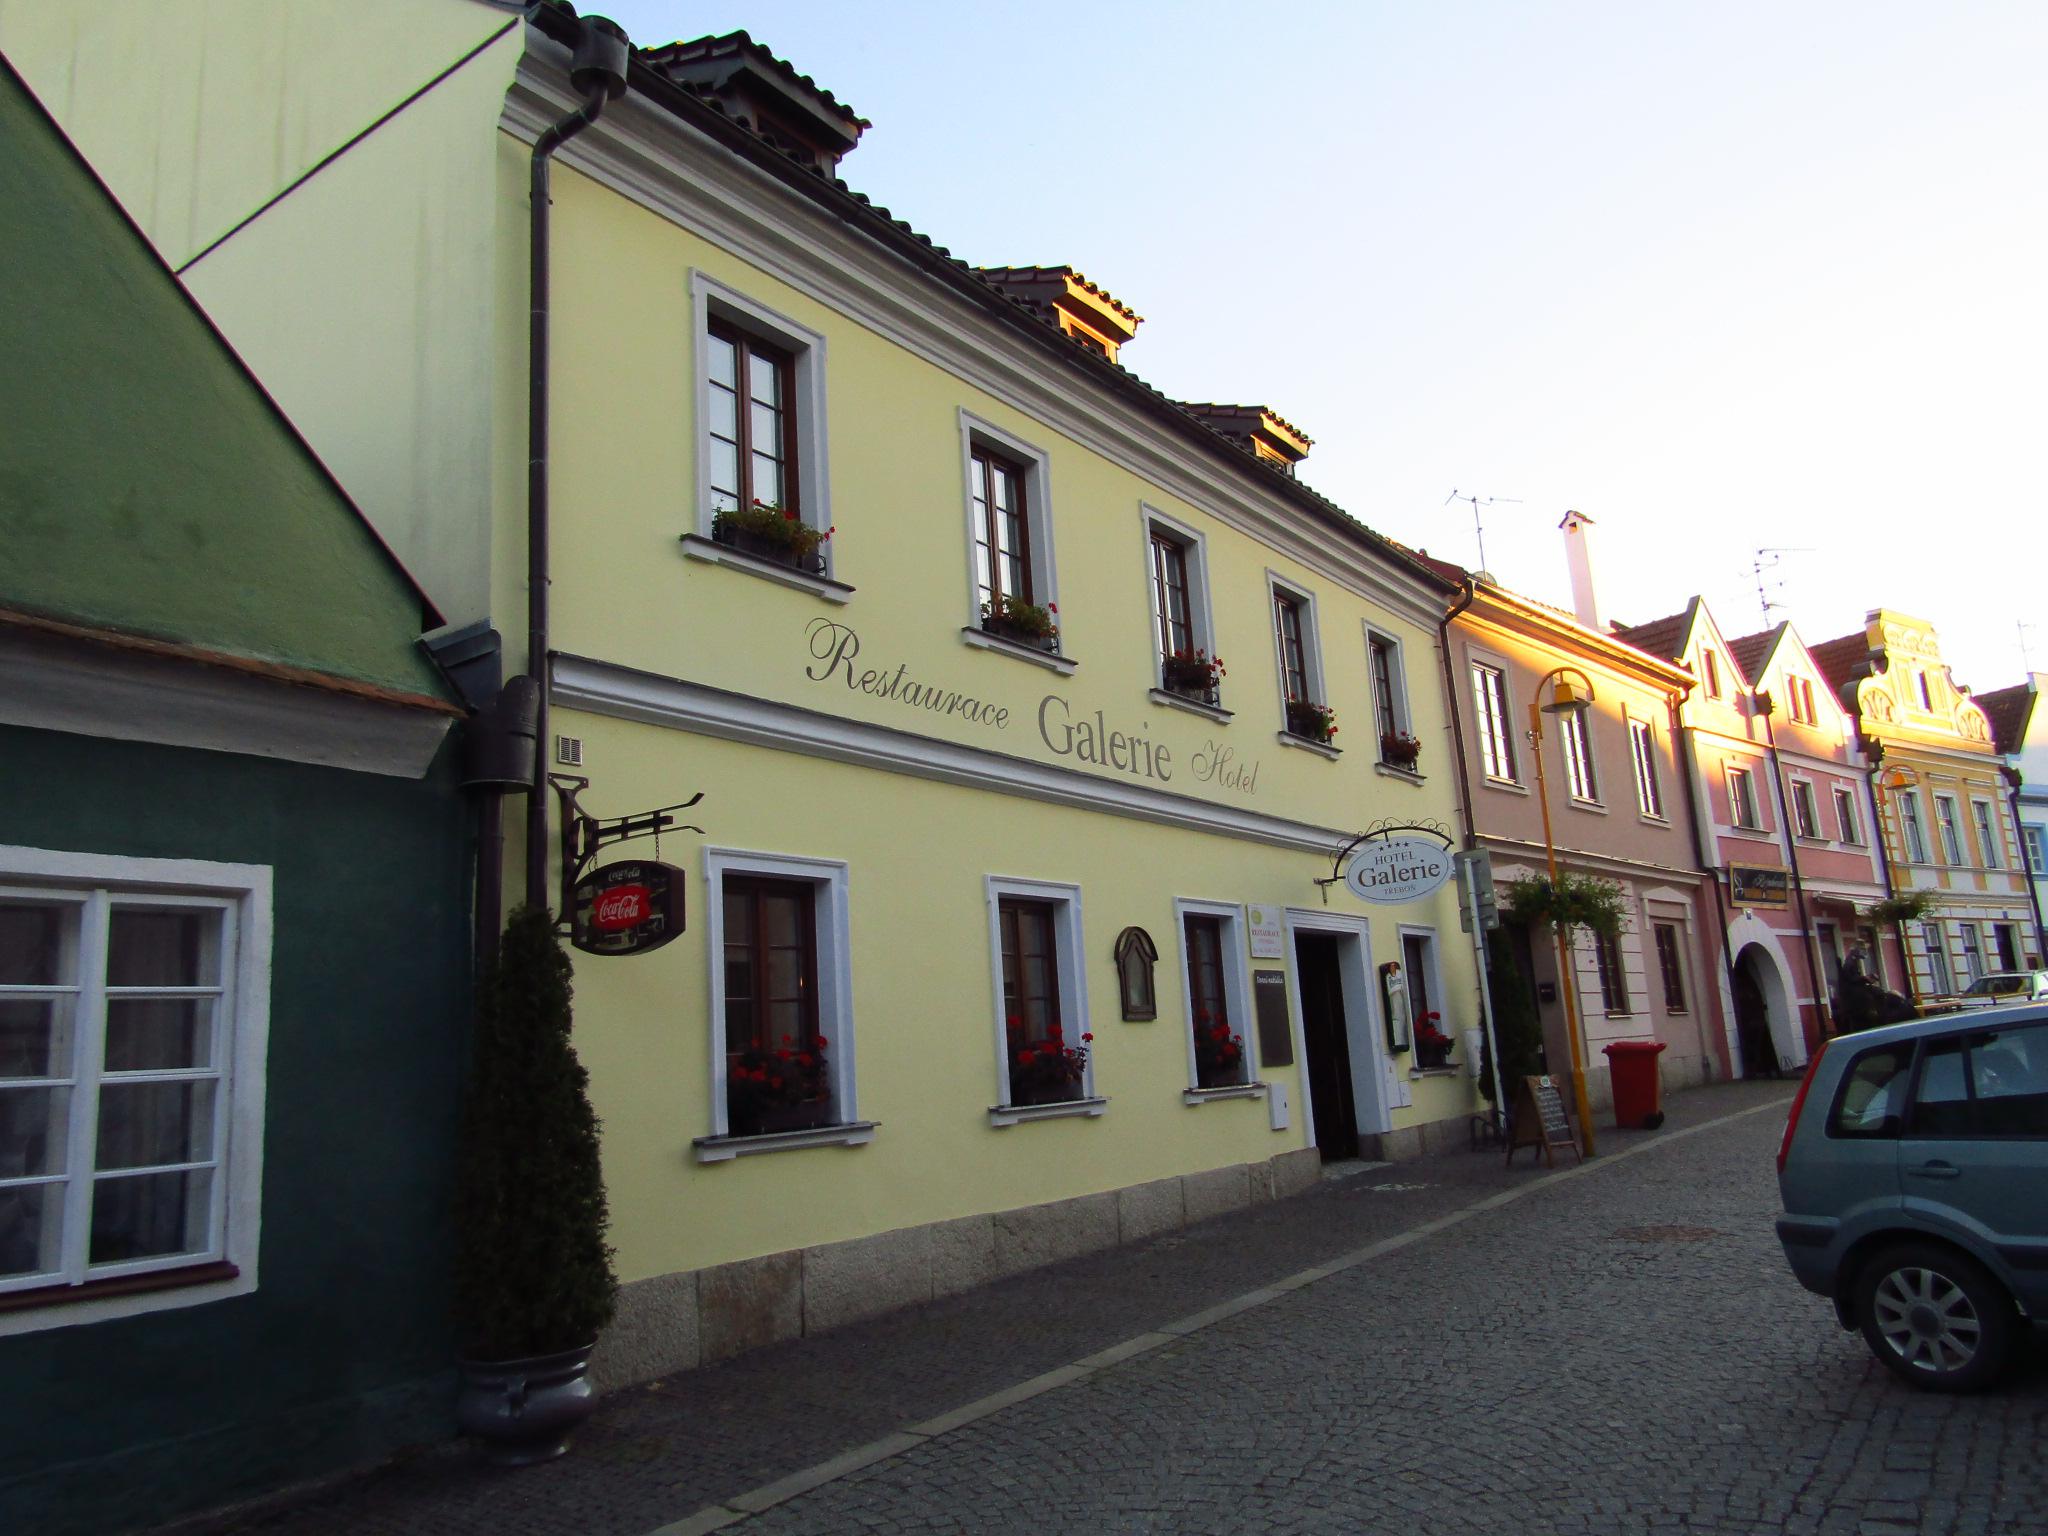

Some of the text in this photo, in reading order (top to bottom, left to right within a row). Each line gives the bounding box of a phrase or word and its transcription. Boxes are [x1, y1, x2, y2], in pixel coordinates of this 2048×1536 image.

[804, 617, 1259, 796] Restaurace Galerie Hotel
[1375, 851, 1416, 866] HOTEL
[1358, 859, 1441, 888] Galerie
